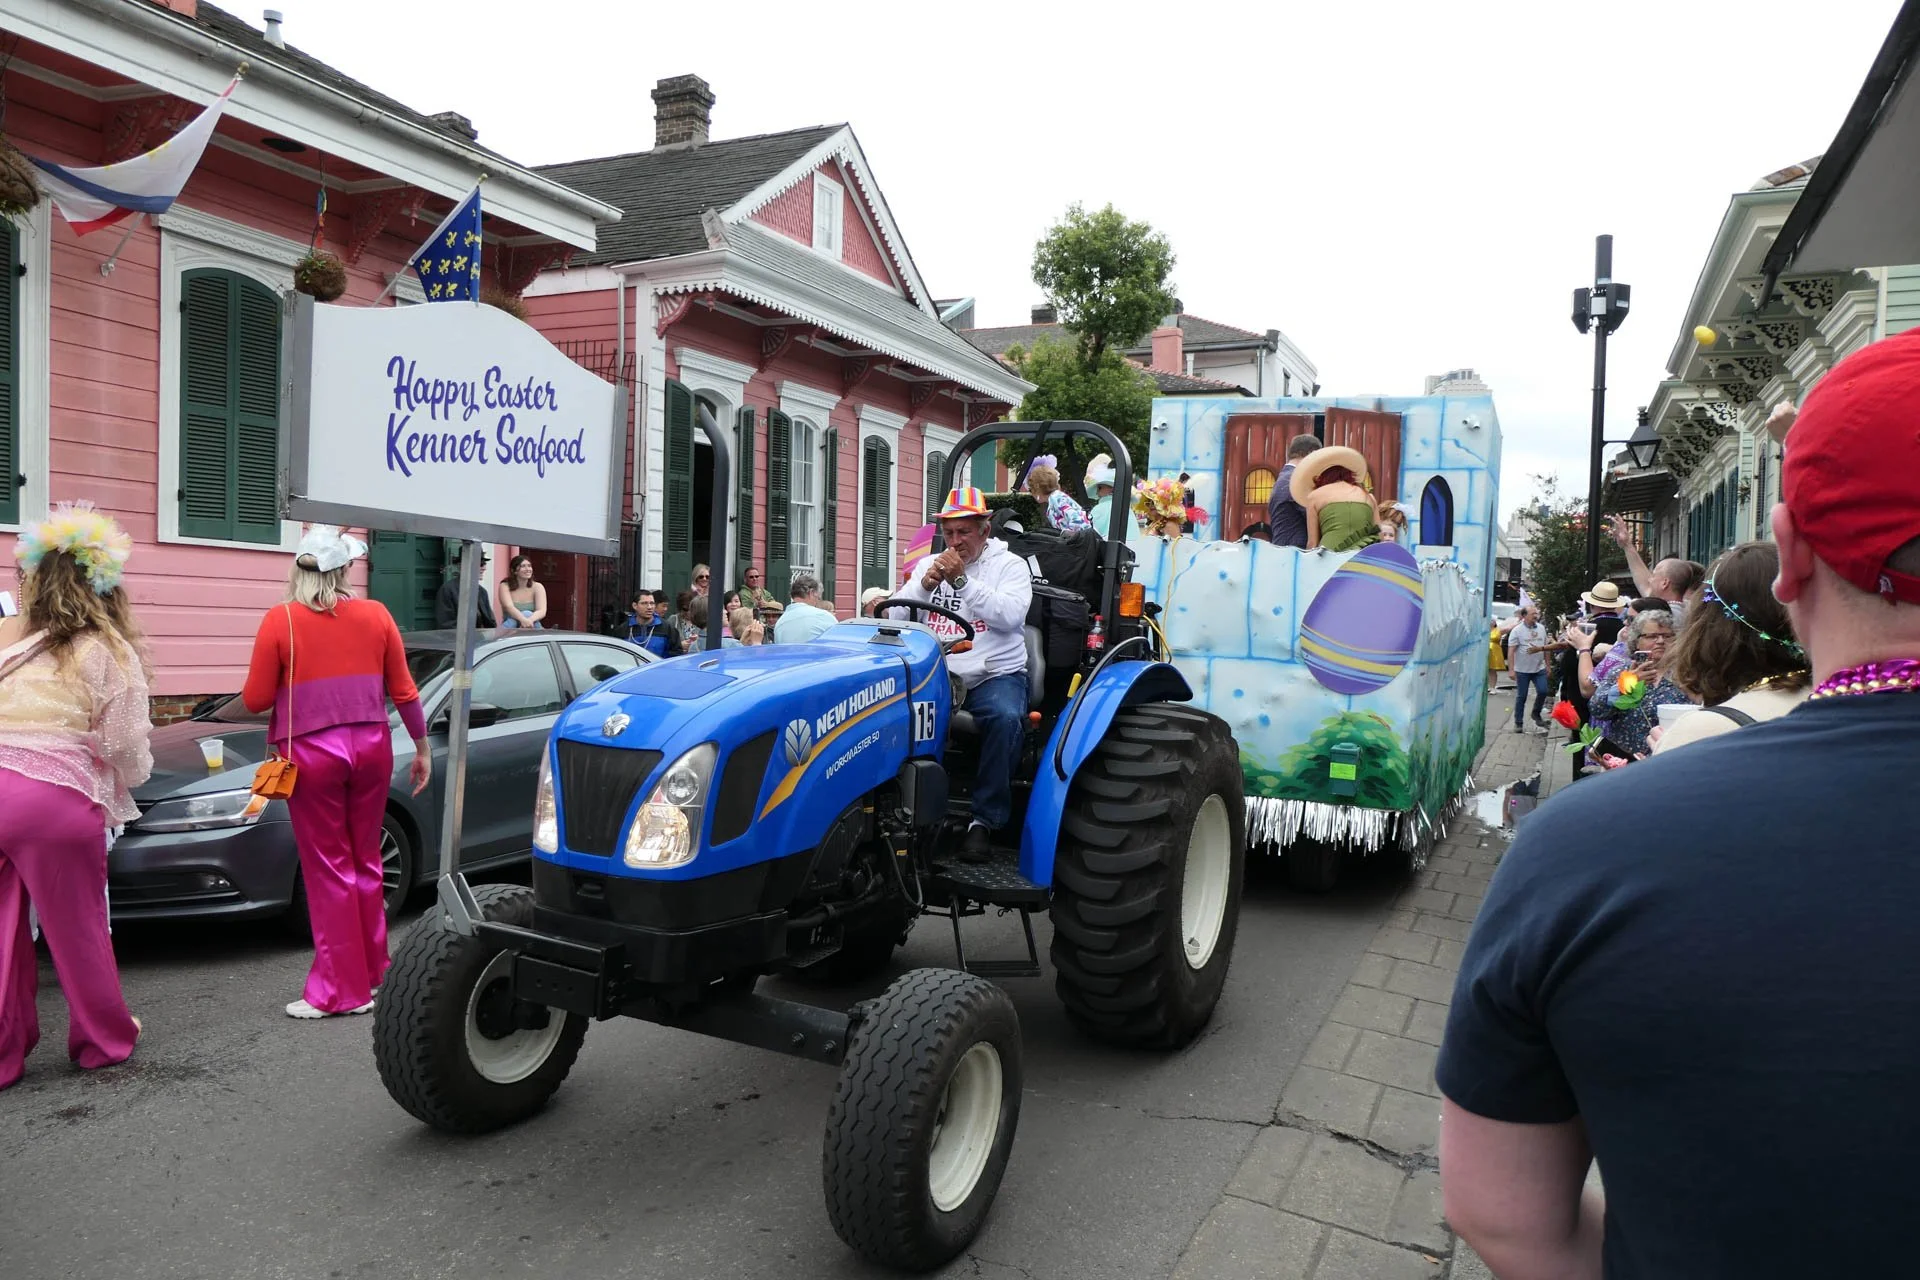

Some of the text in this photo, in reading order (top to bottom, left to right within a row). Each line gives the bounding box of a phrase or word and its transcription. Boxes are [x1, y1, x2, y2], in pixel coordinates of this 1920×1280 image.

[386, 355, 559, 421] Happy Easter
[386, 413, 586, 478] Kenner Seafood
[816, 677, 896, 739] NEW HOLLAND
[918, 702, 935, 740] 15
[825, 730, 880, 780] WORKMASTER 50
